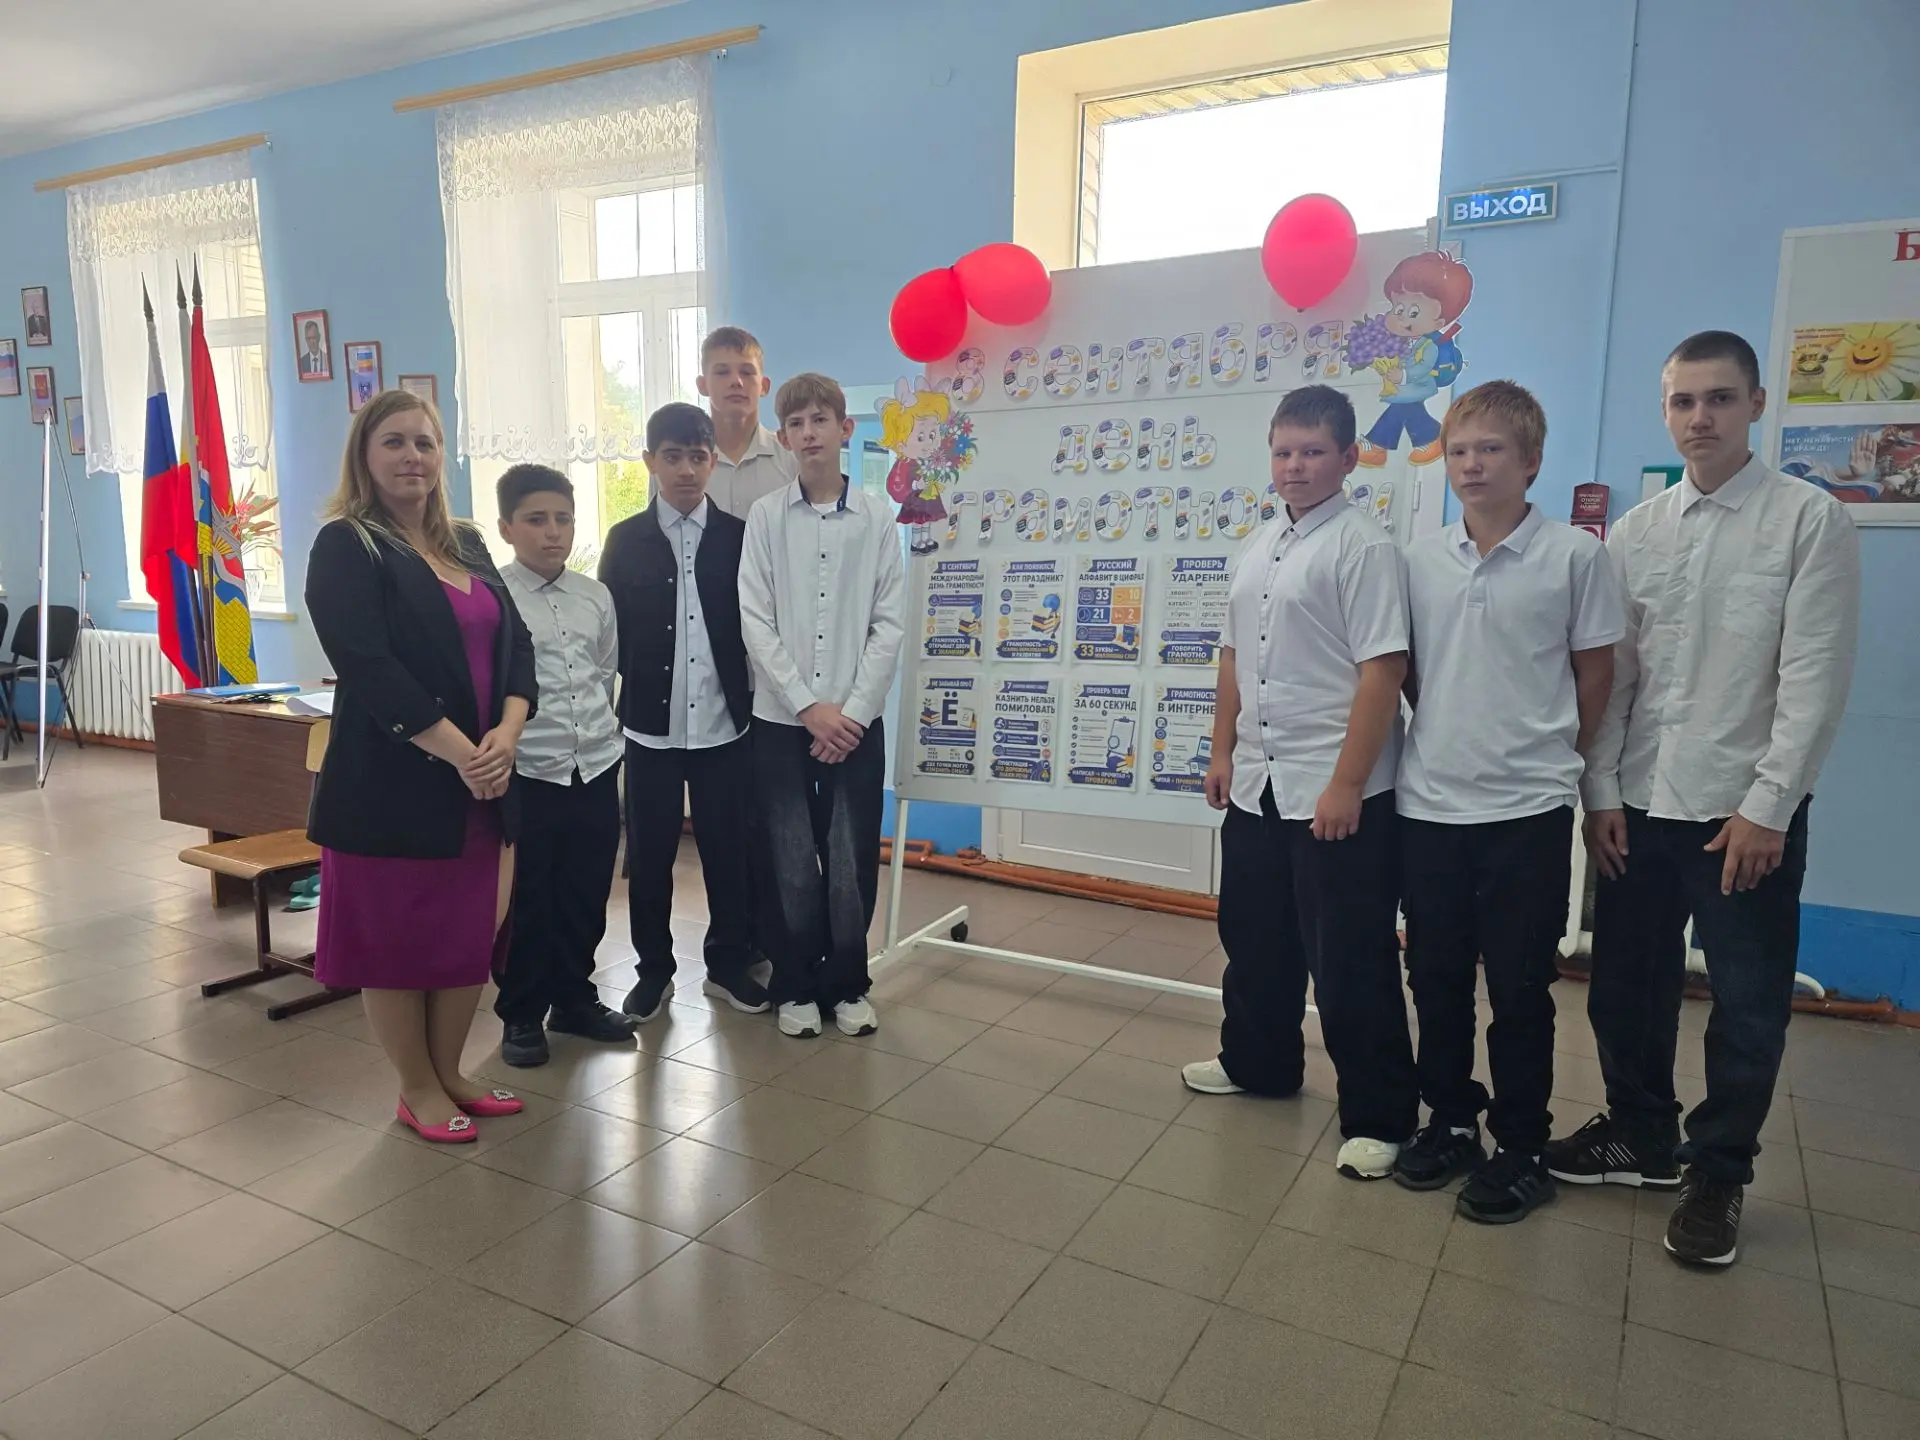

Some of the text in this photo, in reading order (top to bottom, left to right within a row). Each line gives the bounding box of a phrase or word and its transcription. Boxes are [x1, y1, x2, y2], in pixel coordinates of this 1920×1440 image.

[1453, 193, 1547, 221] ВЫХОД
[952, 347, 986, 401] 8
[1096, 560, 1132, 570] РУССКИЙ
[1183, 559, 1223, 569] ПРОВЕРЬ
[1002, 574, 1064, 583] ЭТОТ ПРАЗДНИК?
[1172, 573, 1230, 583] УДАРЕНИЕ
[928, 582, 945, 590] ДЕНЬ
[1095, 589, 1109, 600] 33
[1129, 588, 1140, 600] 10
[1093, 608, 1105, 619] 21
[1128, 608, 1135, 620] 2
[1081, 645, 1094, 657] 33
[1167, 651, 1207, 659] ГРАМОТНО
[995, 694, 1029, 703] КАЗНИТЬ
[942, 691, 959, 726] Ё
[995, 703, 1055, 714] ПОМИЛОВАТЬ
[1074, 699, 1137, 711] ЗА 60 СЕКУНД
[1157, 702, 1216, 715] В ИНТЕРНЕ
